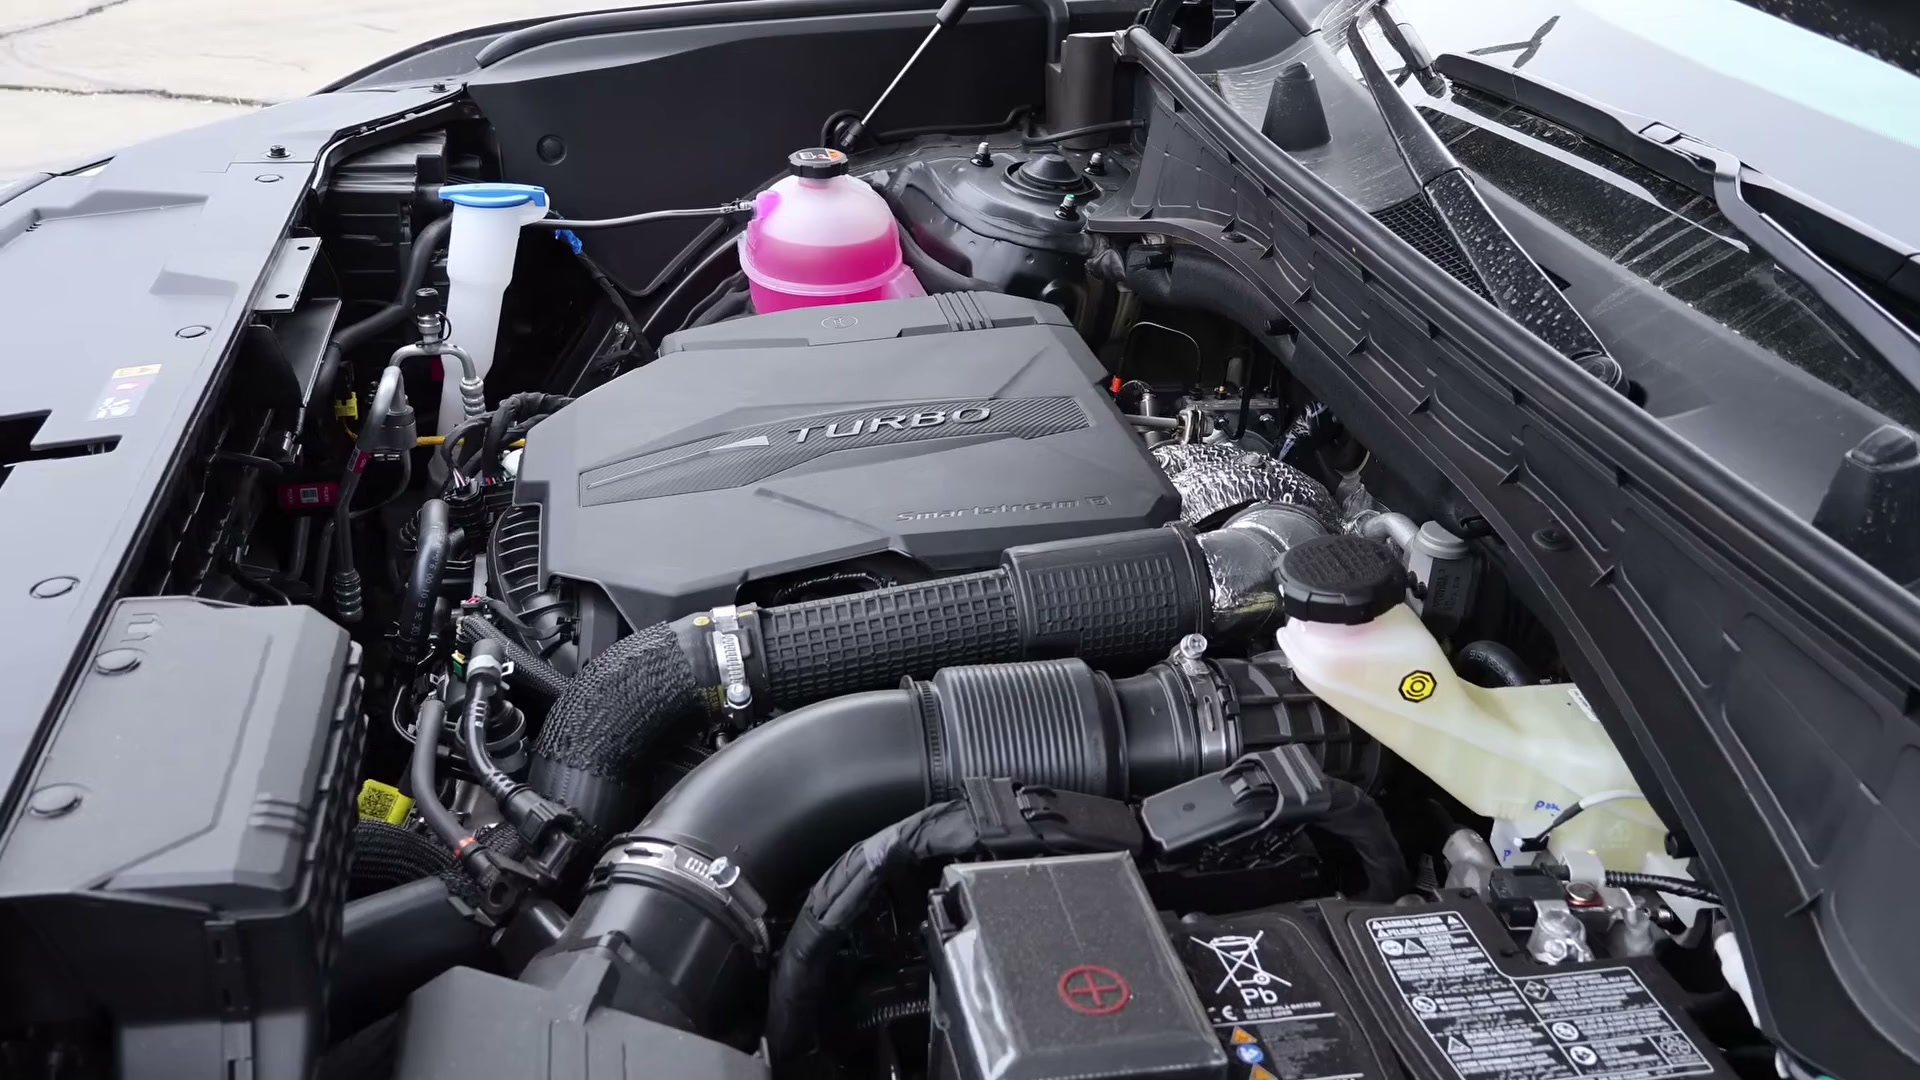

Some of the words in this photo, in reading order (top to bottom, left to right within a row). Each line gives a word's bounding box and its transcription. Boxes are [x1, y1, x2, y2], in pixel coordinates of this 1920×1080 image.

[789, 407, 991, 443] TURBO
[896, 499, 1079, 522] Smartstream
[1240, 987, 1278, 1006] Pb
